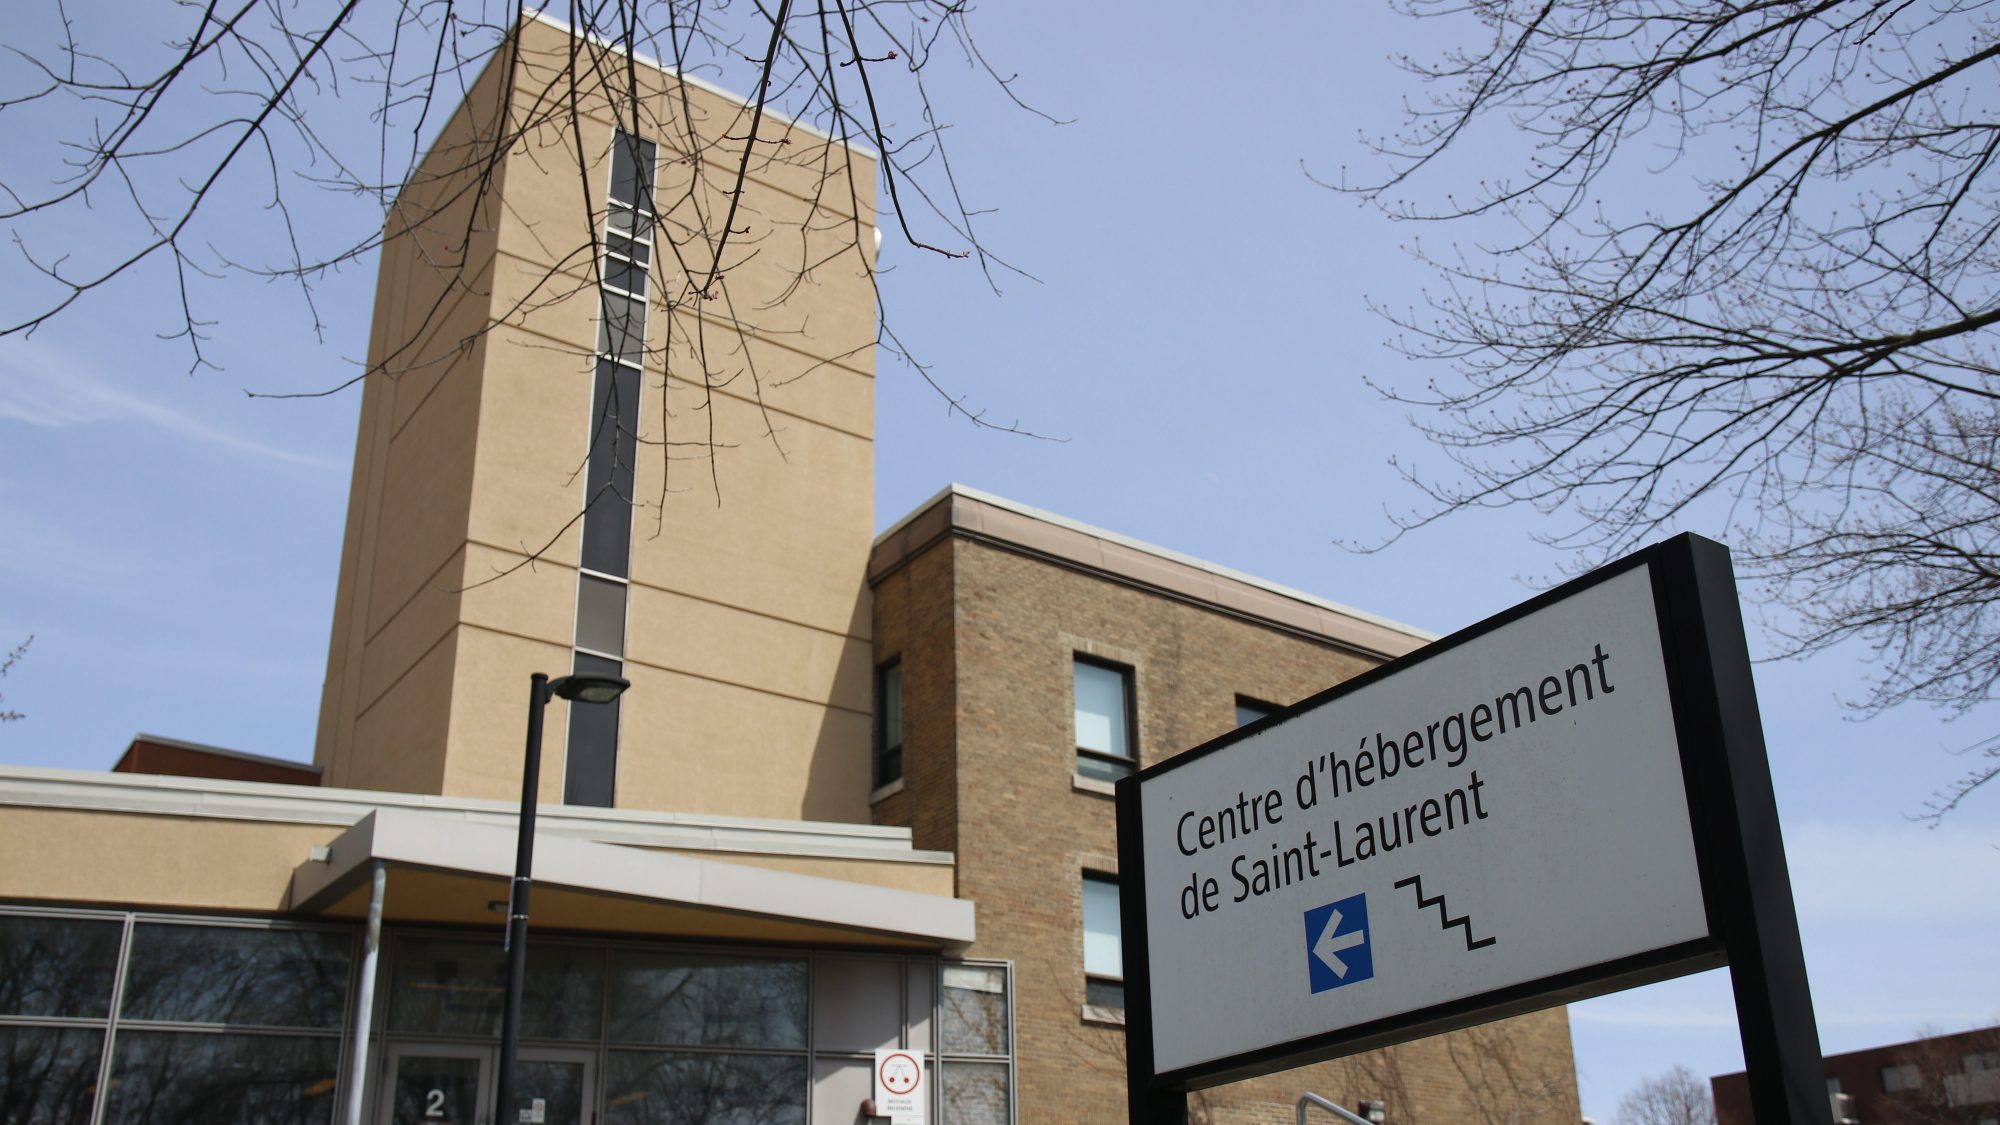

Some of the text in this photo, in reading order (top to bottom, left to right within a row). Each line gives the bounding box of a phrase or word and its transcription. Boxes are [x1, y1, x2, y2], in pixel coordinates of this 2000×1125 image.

[1176, 642, 1616, 857] Centre d’hébergement
[1180, 769, 1489, 920] de Saint-Laurent
[425, 1088, 445, 1117] 2
